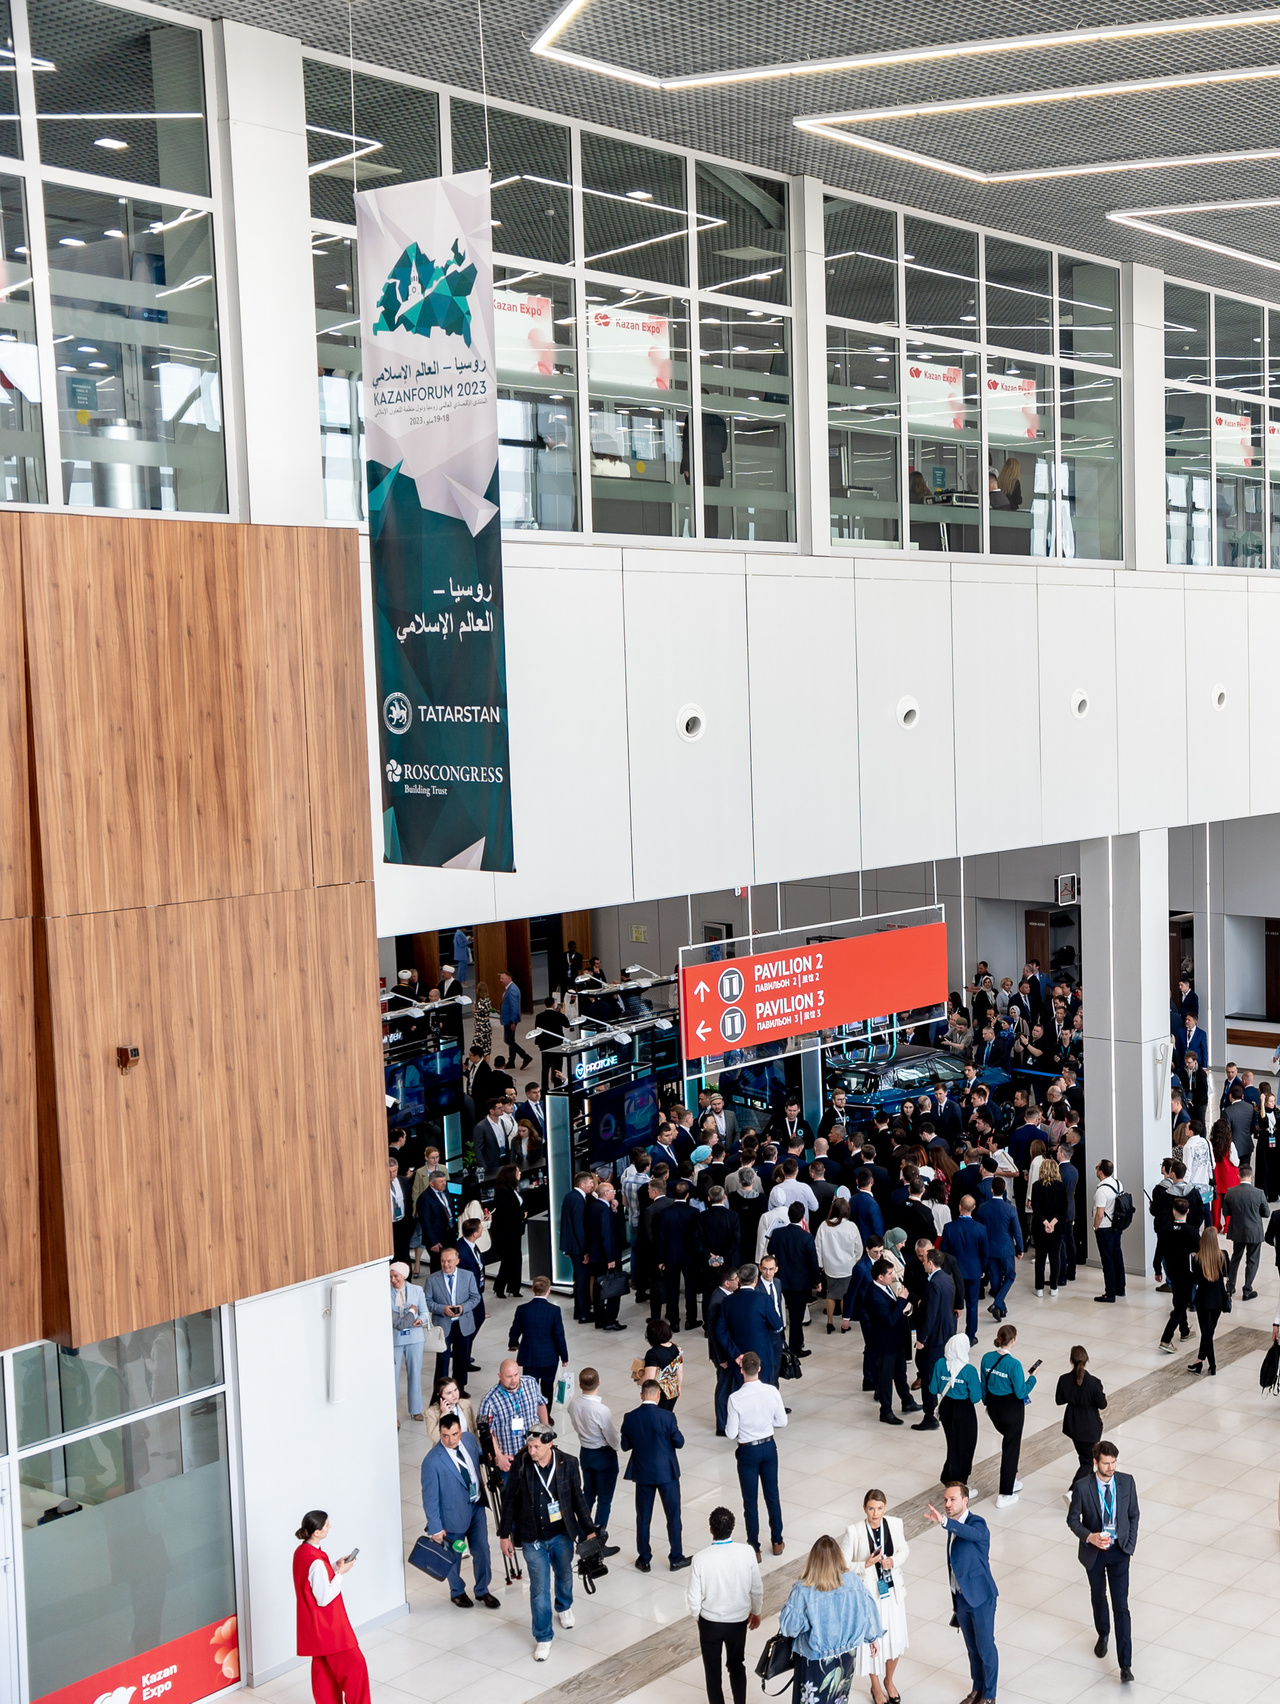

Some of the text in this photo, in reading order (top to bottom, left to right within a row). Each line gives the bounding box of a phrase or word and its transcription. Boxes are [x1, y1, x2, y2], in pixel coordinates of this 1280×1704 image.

[520, 303, 542, 317] Expo
[615, 318, 660, 335] Kazan Expo
[373, 364, 411, 389] الإسلامي
[415, 360, 439, 384] العالم
[455, 357, 486, 375] روسيا
[924, 371, 956, 384] Kazan Expo
[1001, 383, 1017, 392] Kazan
[374, 380, 487, 406] KAZANFORUM 2023
[410, 417, 423, 425] 2023
[449, 577, 492, 603] روسيا
[396, 610, 494, 643] العالم الإسلامي
[418, 706, 500, 723] TATARSTAN
[403, 764, 503, 783] ROSCONGRESS
[404, 784, 448, 797] Building Trust
[754, 953, 823, 981] PAVILION 2
[755, 979, 790, 993] ПАВИЛЬОН
[793, 977, 797, 985] 2
[815, 973, 820, 981] 2
[756, 990, 825, 1019] PAVILION 3
[757, 1016, 791, 1031] ПАВИЛЬОН
[794, 1014, 799, 1023] 3
[817, 1009, 821, 1018] 3
[142, 1663, 177, 1688] Kazan
[142, 1679, 172, 1702] Expo
